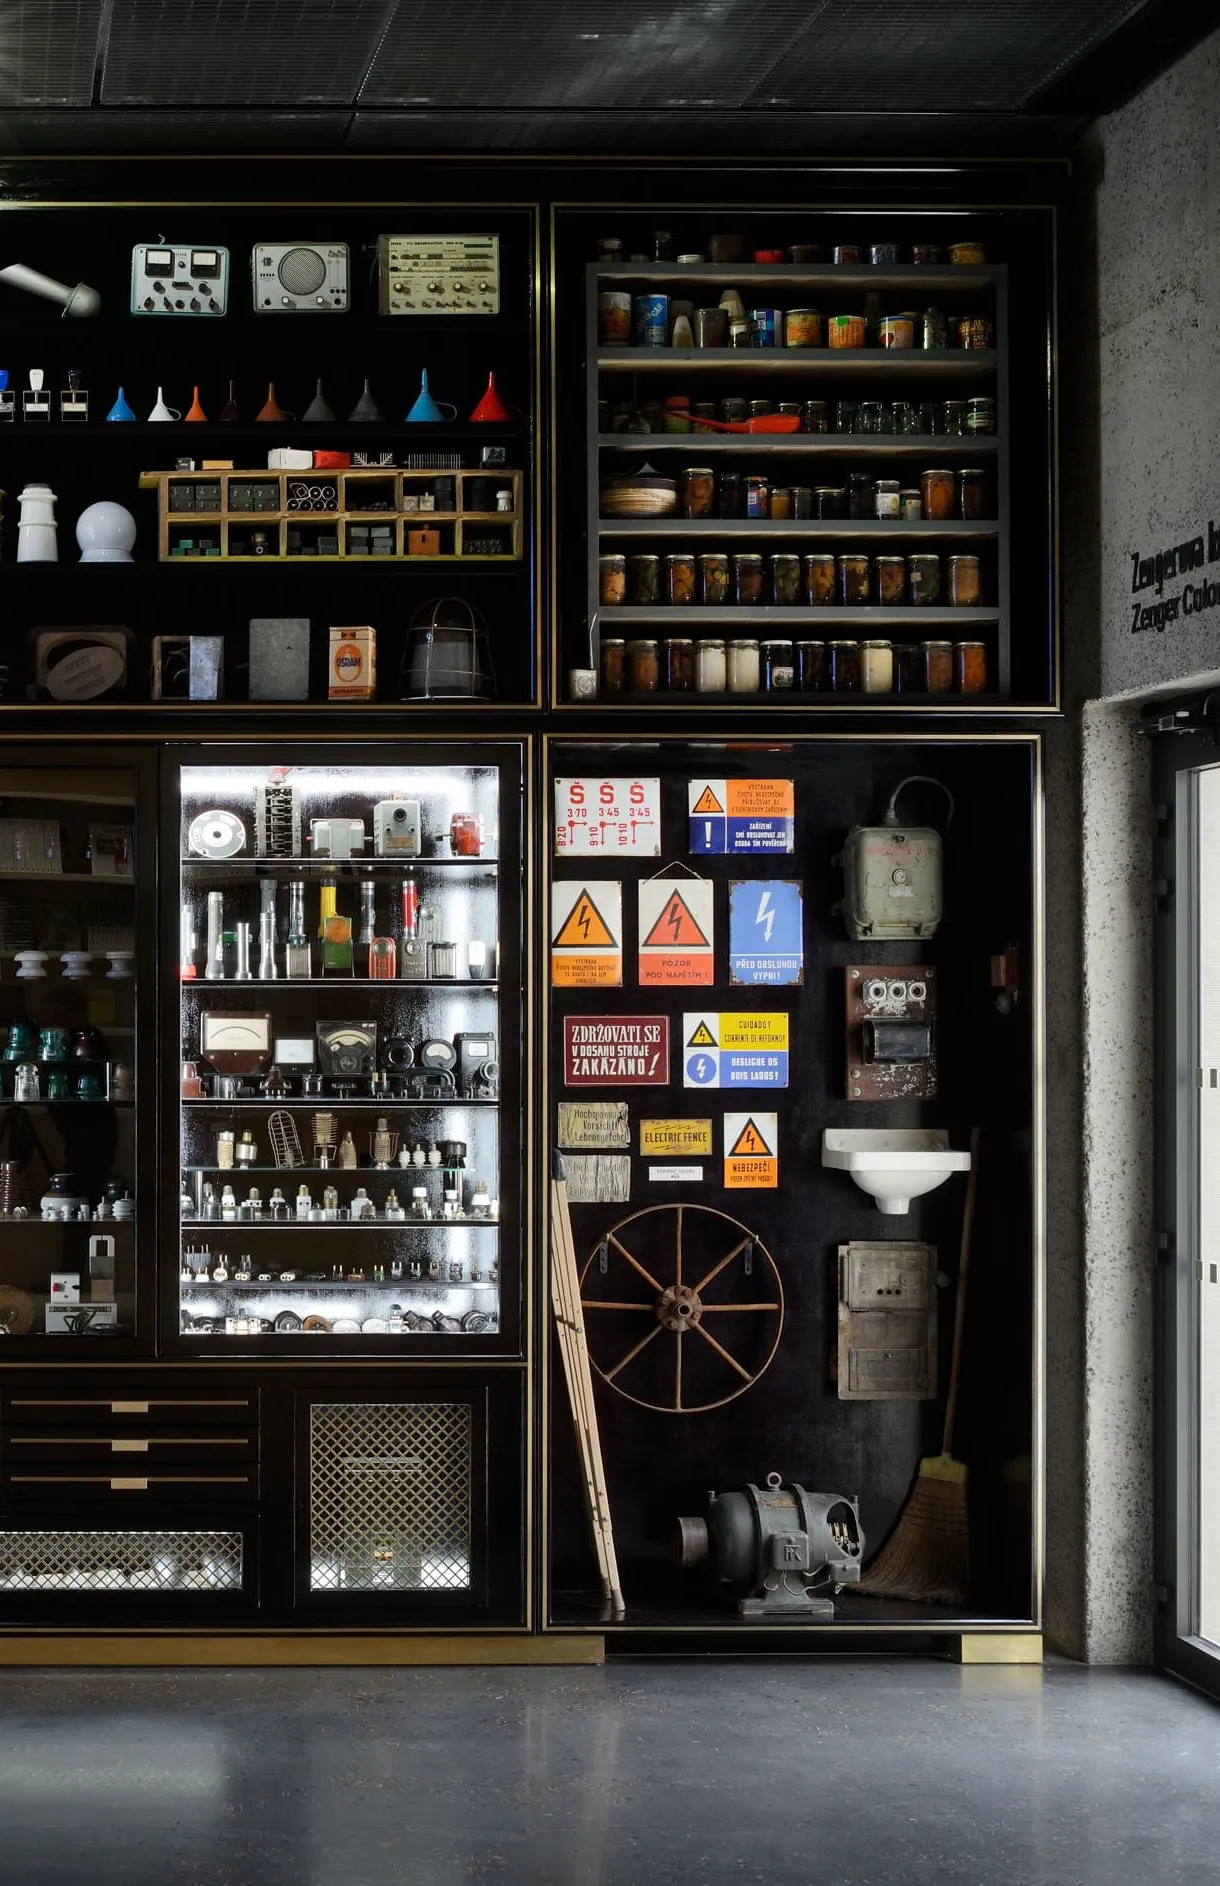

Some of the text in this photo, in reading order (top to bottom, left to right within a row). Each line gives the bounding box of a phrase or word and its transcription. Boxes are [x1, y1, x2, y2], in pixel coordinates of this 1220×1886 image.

[1131, 596, 1182, 634] Zenger
[736, 959, 797, 969] PŘED OBSLUHOU
[753, 971, 780, 981] VYPNI!
[572, 1023, 660, 1043] ZDRŽOVATI SE
[571, 1045, 650, 1056] V DOSAHU STROJE
[731, 1057, 778, 1067] DESLIGUE OS
[730, 1071, 748, 1081] DOIS
[644, 1132, 708, 1143] ELECTRIC FENCE
[732, 1160, 770, 1172] NEBEZPEČÍ
